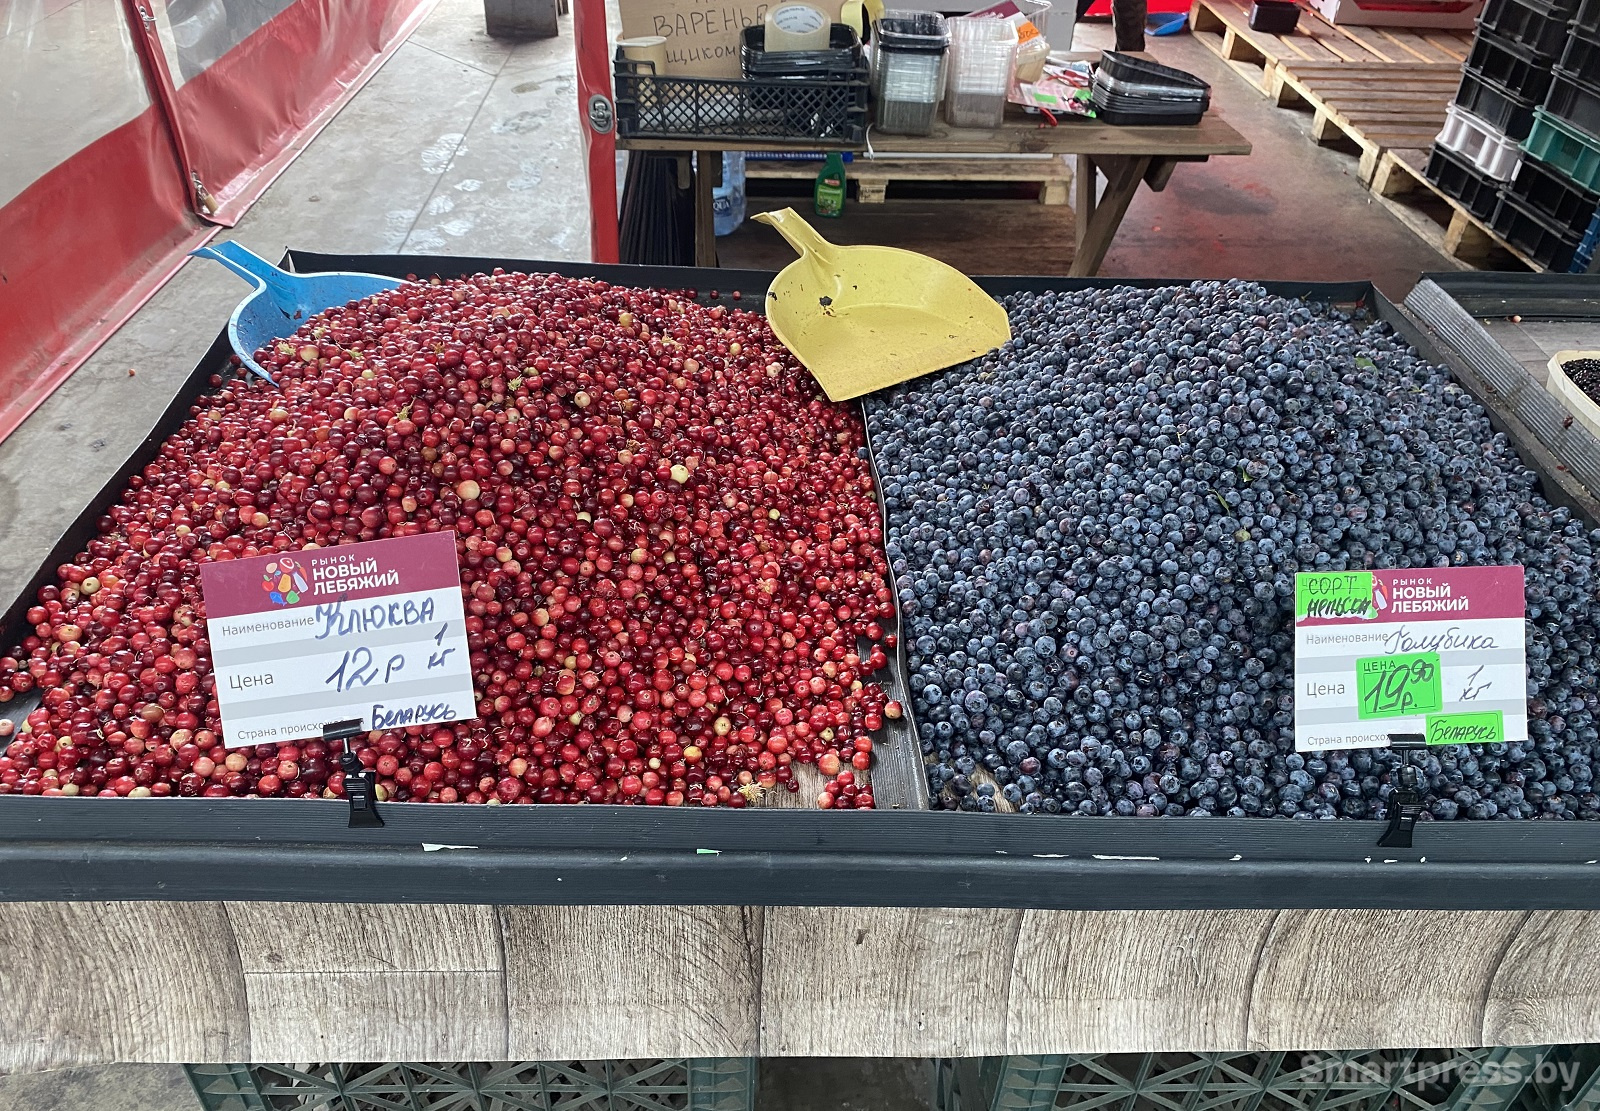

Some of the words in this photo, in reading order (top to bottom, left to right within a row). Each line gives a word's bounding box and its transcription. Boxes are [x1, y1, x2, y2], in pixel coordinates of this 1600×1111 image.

[665, 45, 737, 65] ЩИКОМ
[712, 200, 731, 212] QUA
[311, 553, 356, 566] РЫНОК
[312, 557, 378, 581] НОВЫЙ
[313, 568, 399, 596] ЛЕБЯЖИЙ
[1308, 575, 1358, 595] СОРТ
[1392, 577, 1433, 586] РЫНОК
[1392, 583, 1451, 599] НОВЫЙ
[1391, 596, 1469, 613] ЛЕБЯЖИЙ
[221, 616, 314, 637] Наименование
[434, 622, 448, 646] 1
[1306, 632, 1388, 645] Наименование
[1384, 624, 1500, 655] Голубика
[1363, 660, 1396, 672] ЦЕНА
[229, 671, 274, 691] Цена
[1306, 681, 1346, 697] Цена
[237, 726, 277, 741] Страна
[1307, 735, 1342, 747] Страна
